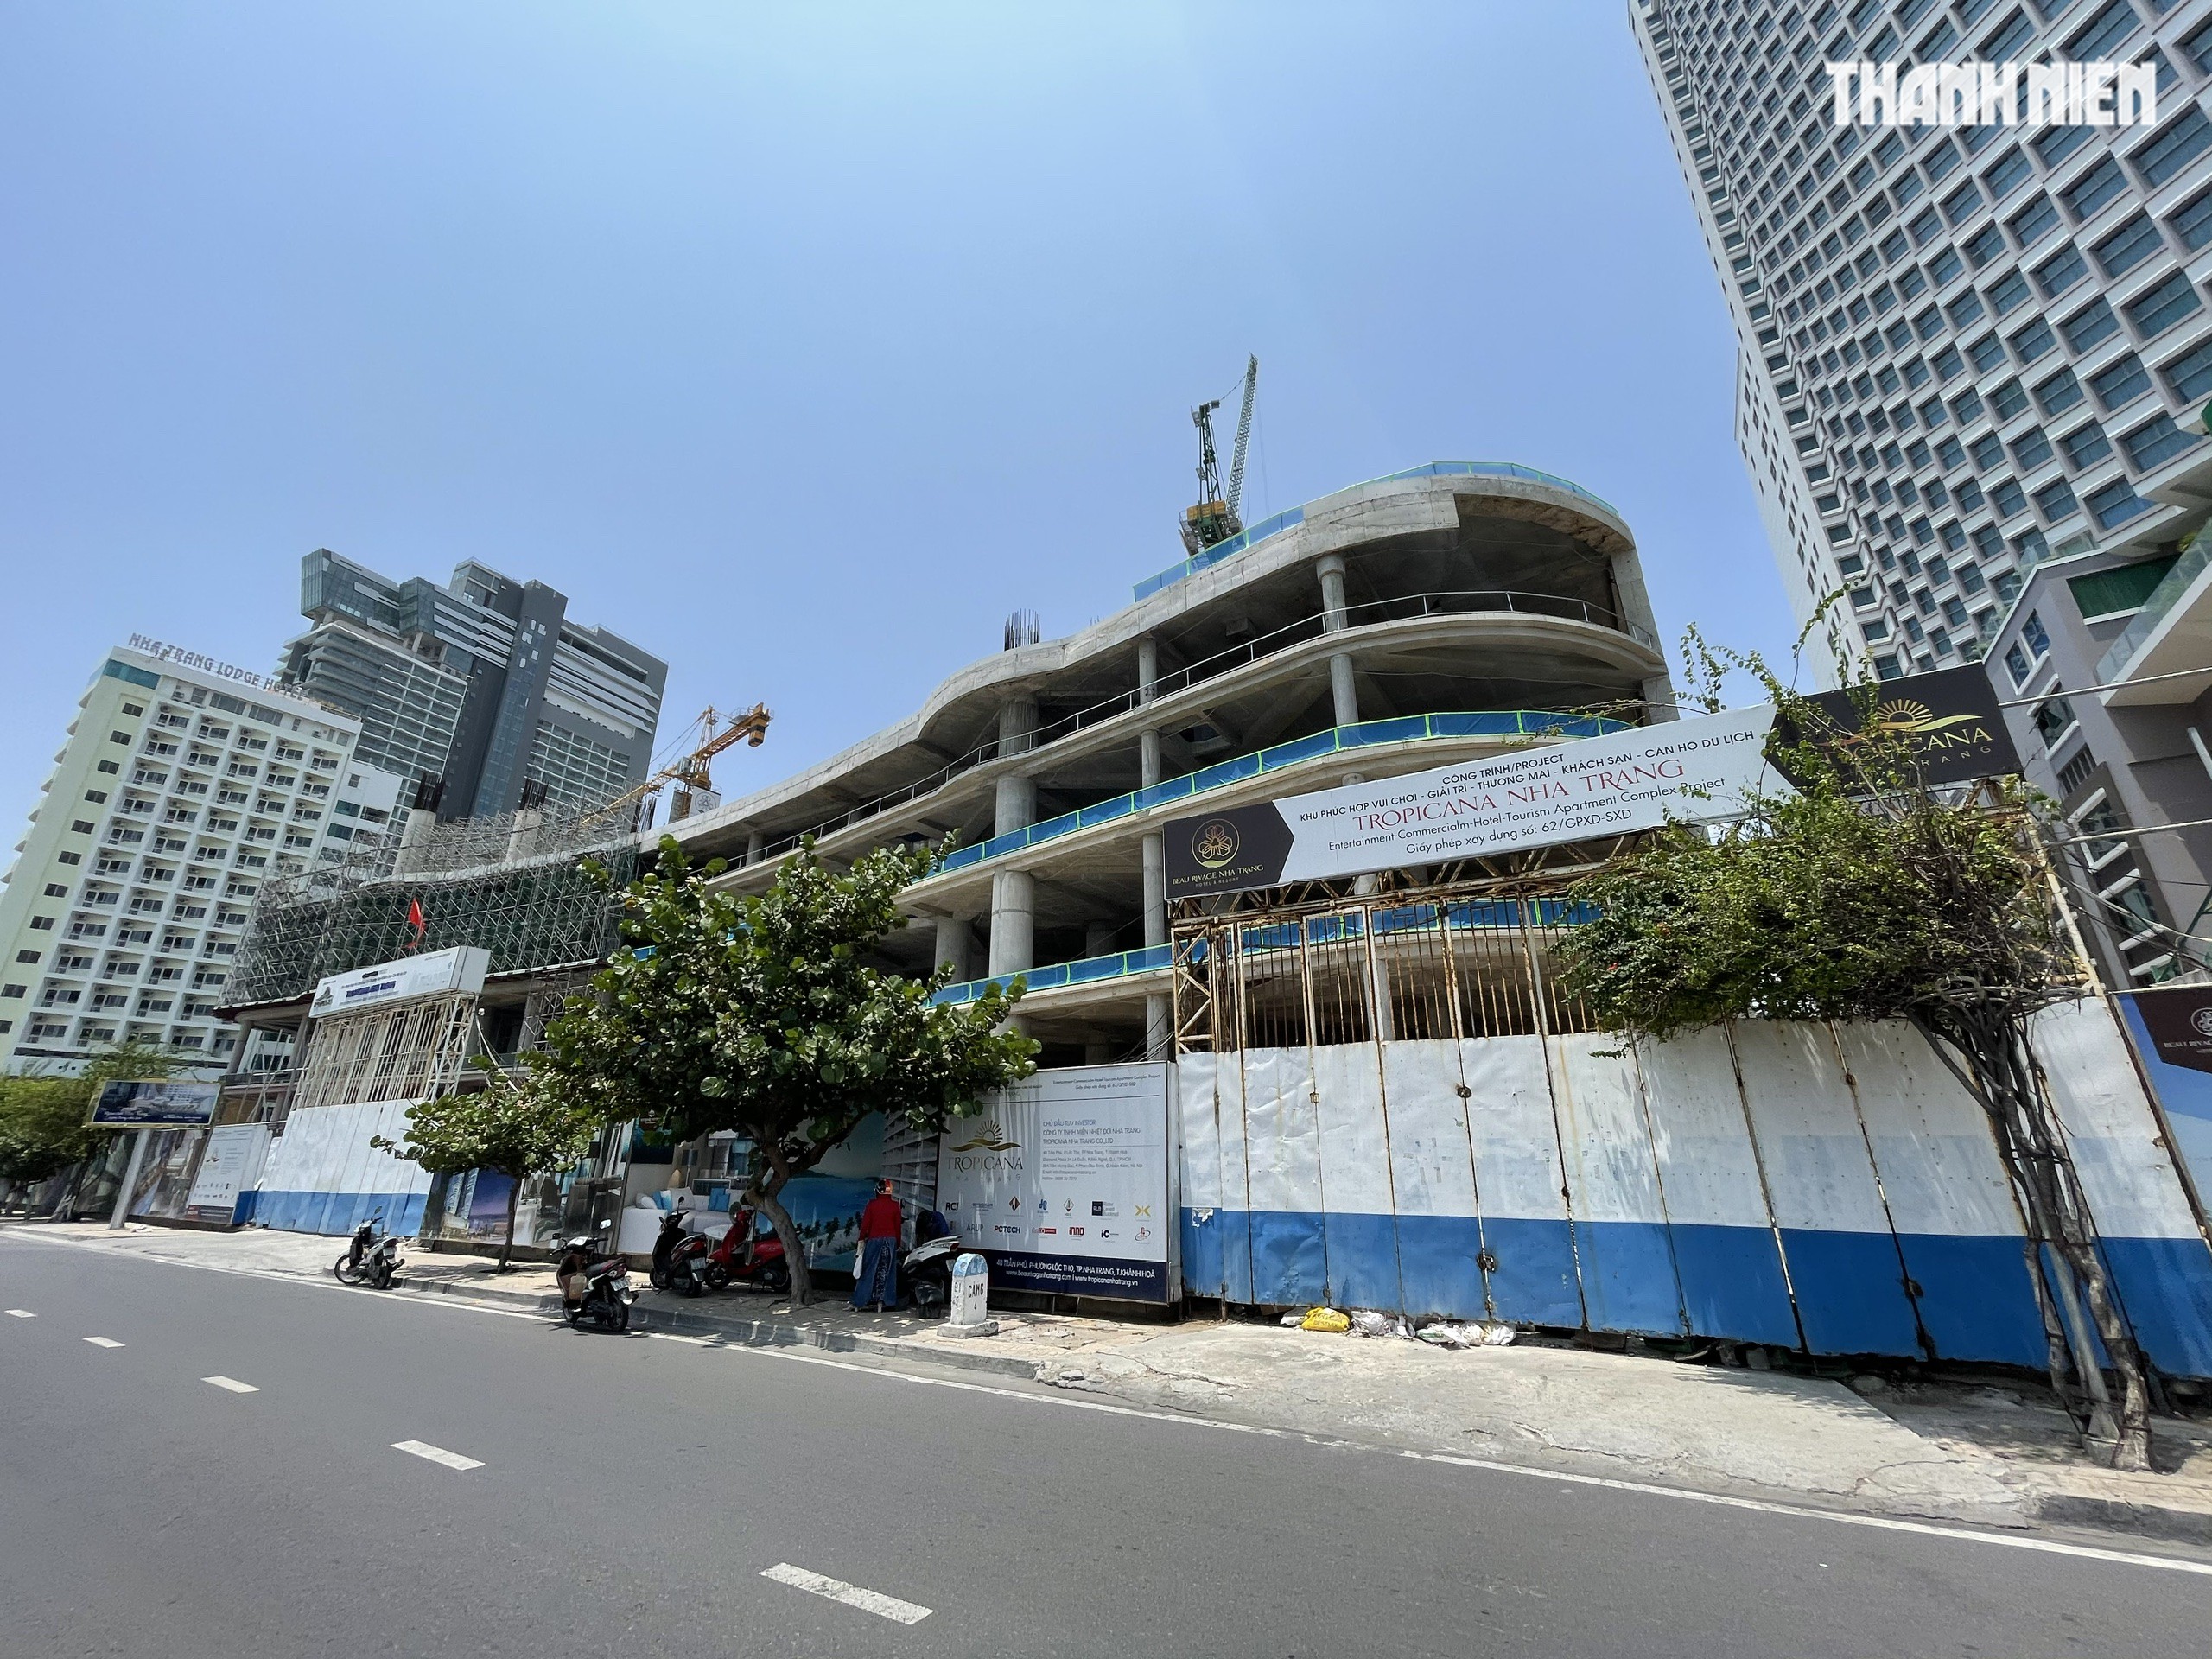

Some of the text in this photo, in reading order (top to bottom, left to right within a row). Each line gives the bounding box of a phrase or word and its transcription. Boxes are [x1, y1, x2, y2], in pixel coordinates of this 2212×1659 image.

[128, 632, 310, 699] NHA TRANG LODGE HOTEL
[1442, 754, 1565, 785] CÔNG TRÌNH/PROJECT
[1910, 745, 1993, 768] RANG
[1300, 811, 1319, 822] KHU
[1349, 802, 1370, 814] HỢP
[1371, 798, 1389, 809] VUI
[1391, 793, 1417, 804] CHƠI
[1427, 786, 1451, 798] GIẢI
[1453, 783, 1467, 794] TRÍ
[1478, 774, 1525, 790] THƯƠNG
[1529, 769, 1550, 781] MẠI
[1562, 758, 1605, 775] KHÁCH
[1607, 753, 1632, 766] SẠN
[1644, 745, 1675, 759] CĂN
[1678, 740, 1699, 753] HỘ
[1702, 737, 1720, 749] DU
[1725, 730, 1755, 746] LỊCH
[1352, 759, 1684, 831] TROPICANA NHA TRANG
[1329, 777, 1726, 851] Entertainment-Commercialm-Hotel-Tourism Apartment Complex Project
[1406, 809, 1632, 855] Giấy phép xây dựng số: 62/GPXD-SXD
[1192, 871, 1217, 882] RIVAGE
[1218, 869, 1236, 878] NHA
[1237, 864, 1264, 874] TRANG
[947, 1156, 1023, 1173] TROPICANA
[945, 1202, 959, 1211] RCI
